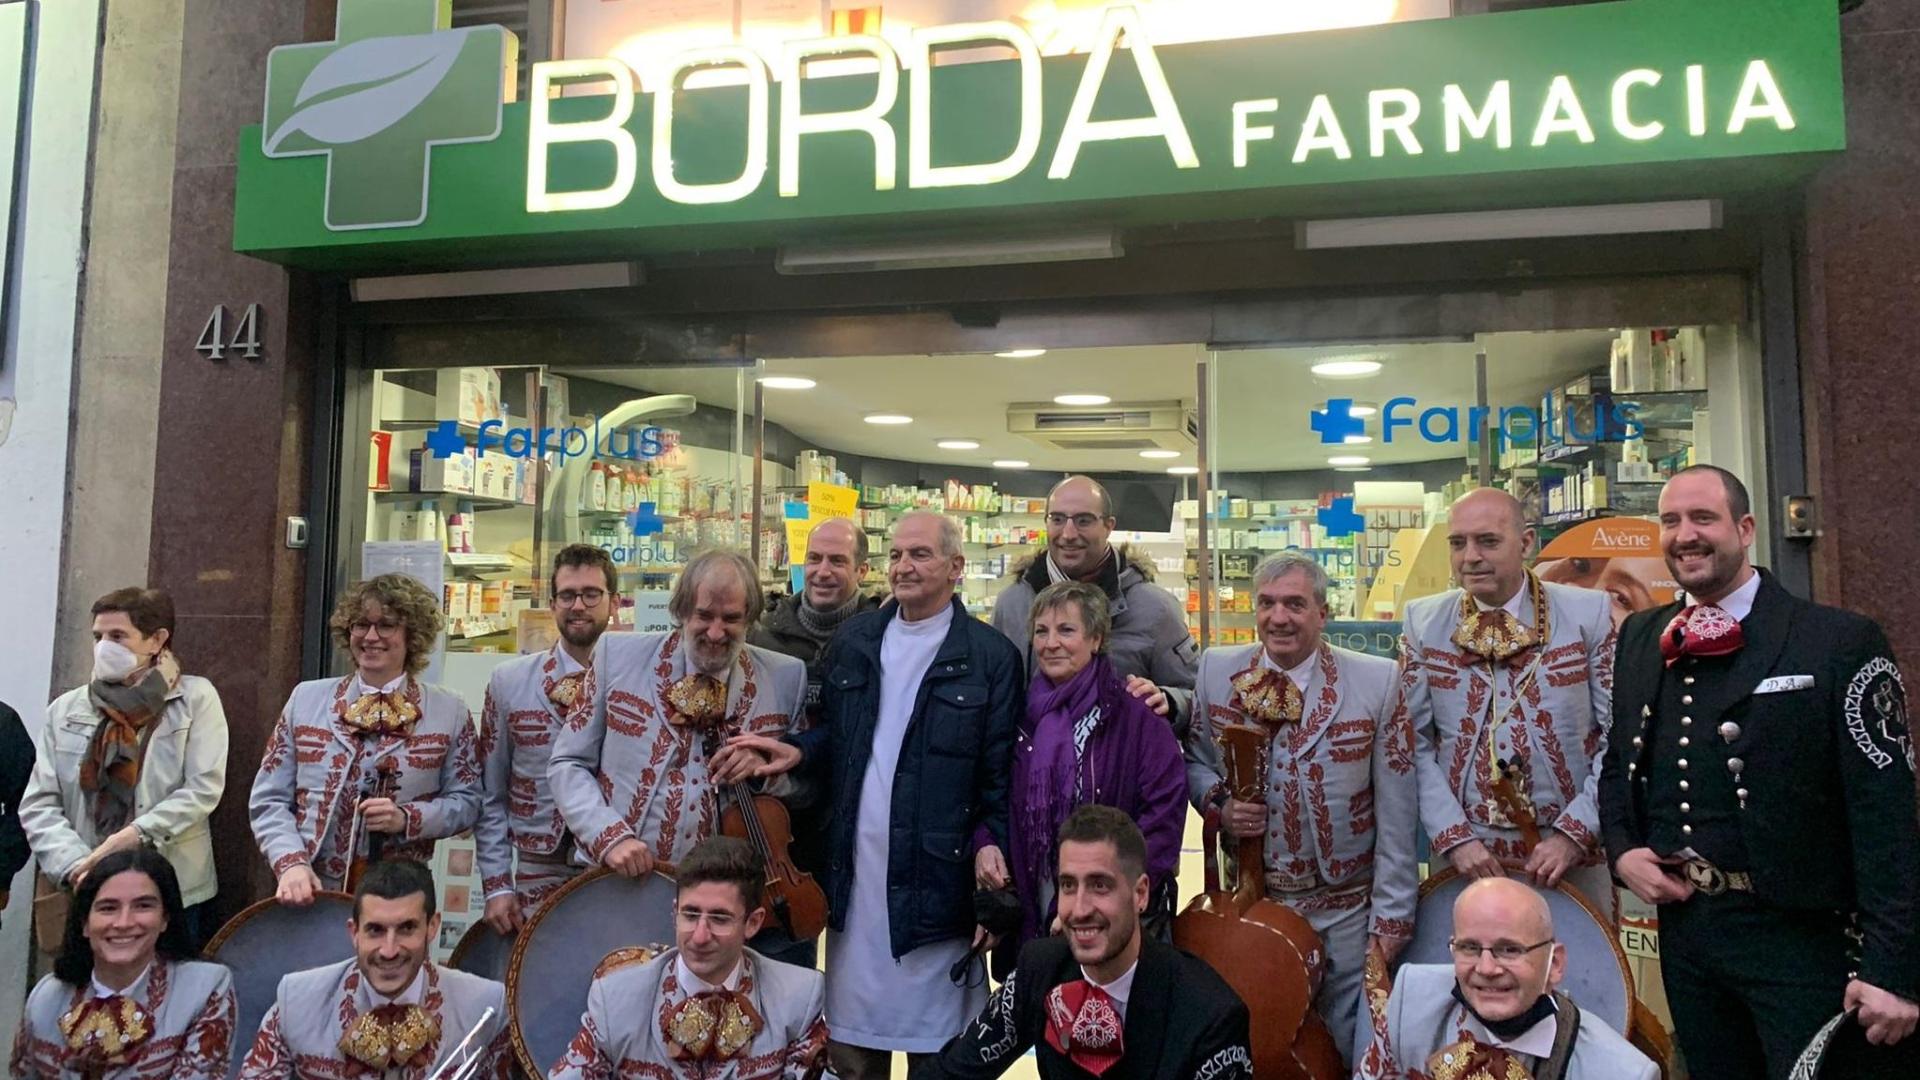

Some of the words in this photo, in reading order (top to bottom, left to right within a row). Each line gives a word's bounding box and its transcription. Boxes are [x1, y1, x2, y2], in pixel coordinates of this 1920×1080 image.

[526, 6, 1200, 213] BORDA
[1232, 59, 1796, 168] FARMACIA
[194, 303, 262, 360] 44
[477, 415, 665, 467] farplus
[1382, 391, 1645, 454] farplus
[1285, 543, 1402, 574] arplus
[1591, 527, 1651, 547] Avène
[1621, 930, 1658, 953] EN
